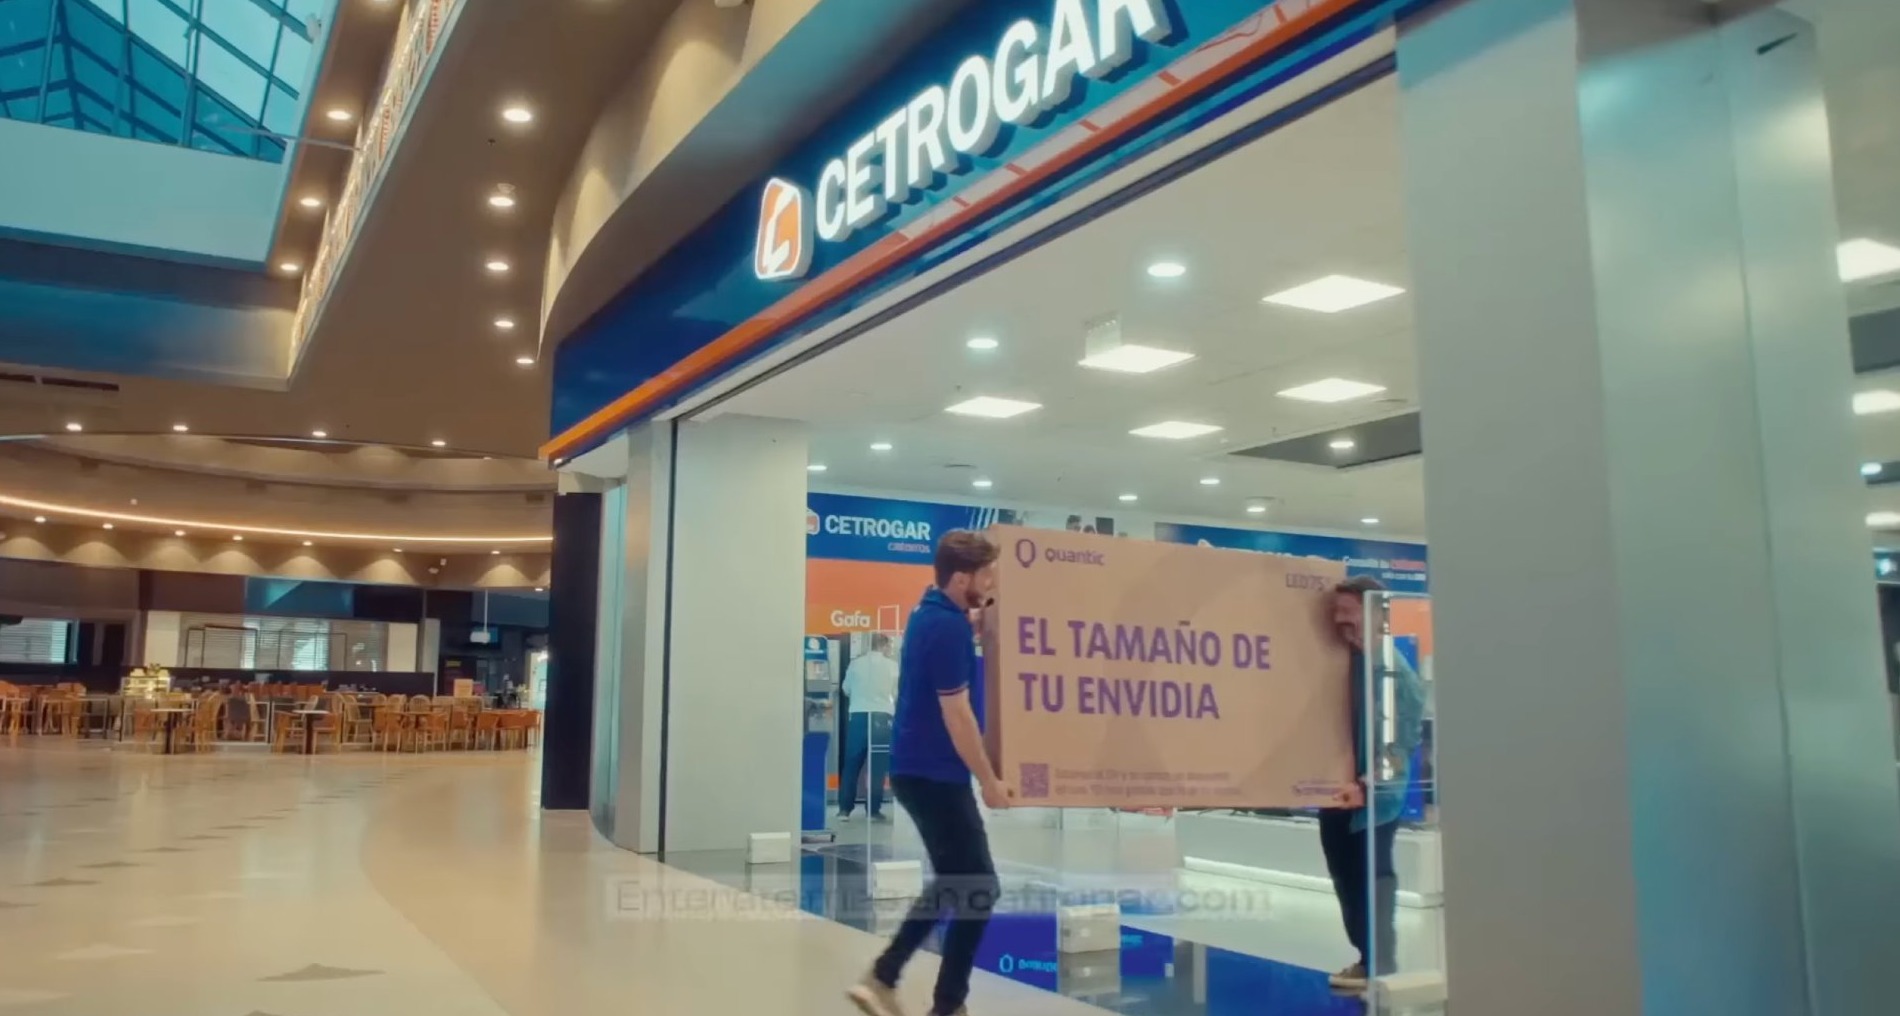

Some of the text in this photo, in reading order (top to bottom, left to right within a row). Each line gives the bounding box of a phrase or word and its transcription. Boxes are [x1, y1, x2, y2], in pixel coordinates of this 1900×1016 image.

[825, 514, 931, 541] CETROGAR
[830, 609, 871, 628] Gafa
[1018, 616, 1272, 670] EL TAMAÑO DE
[1018, 672, 1220, 720] TU ENVIDIA
